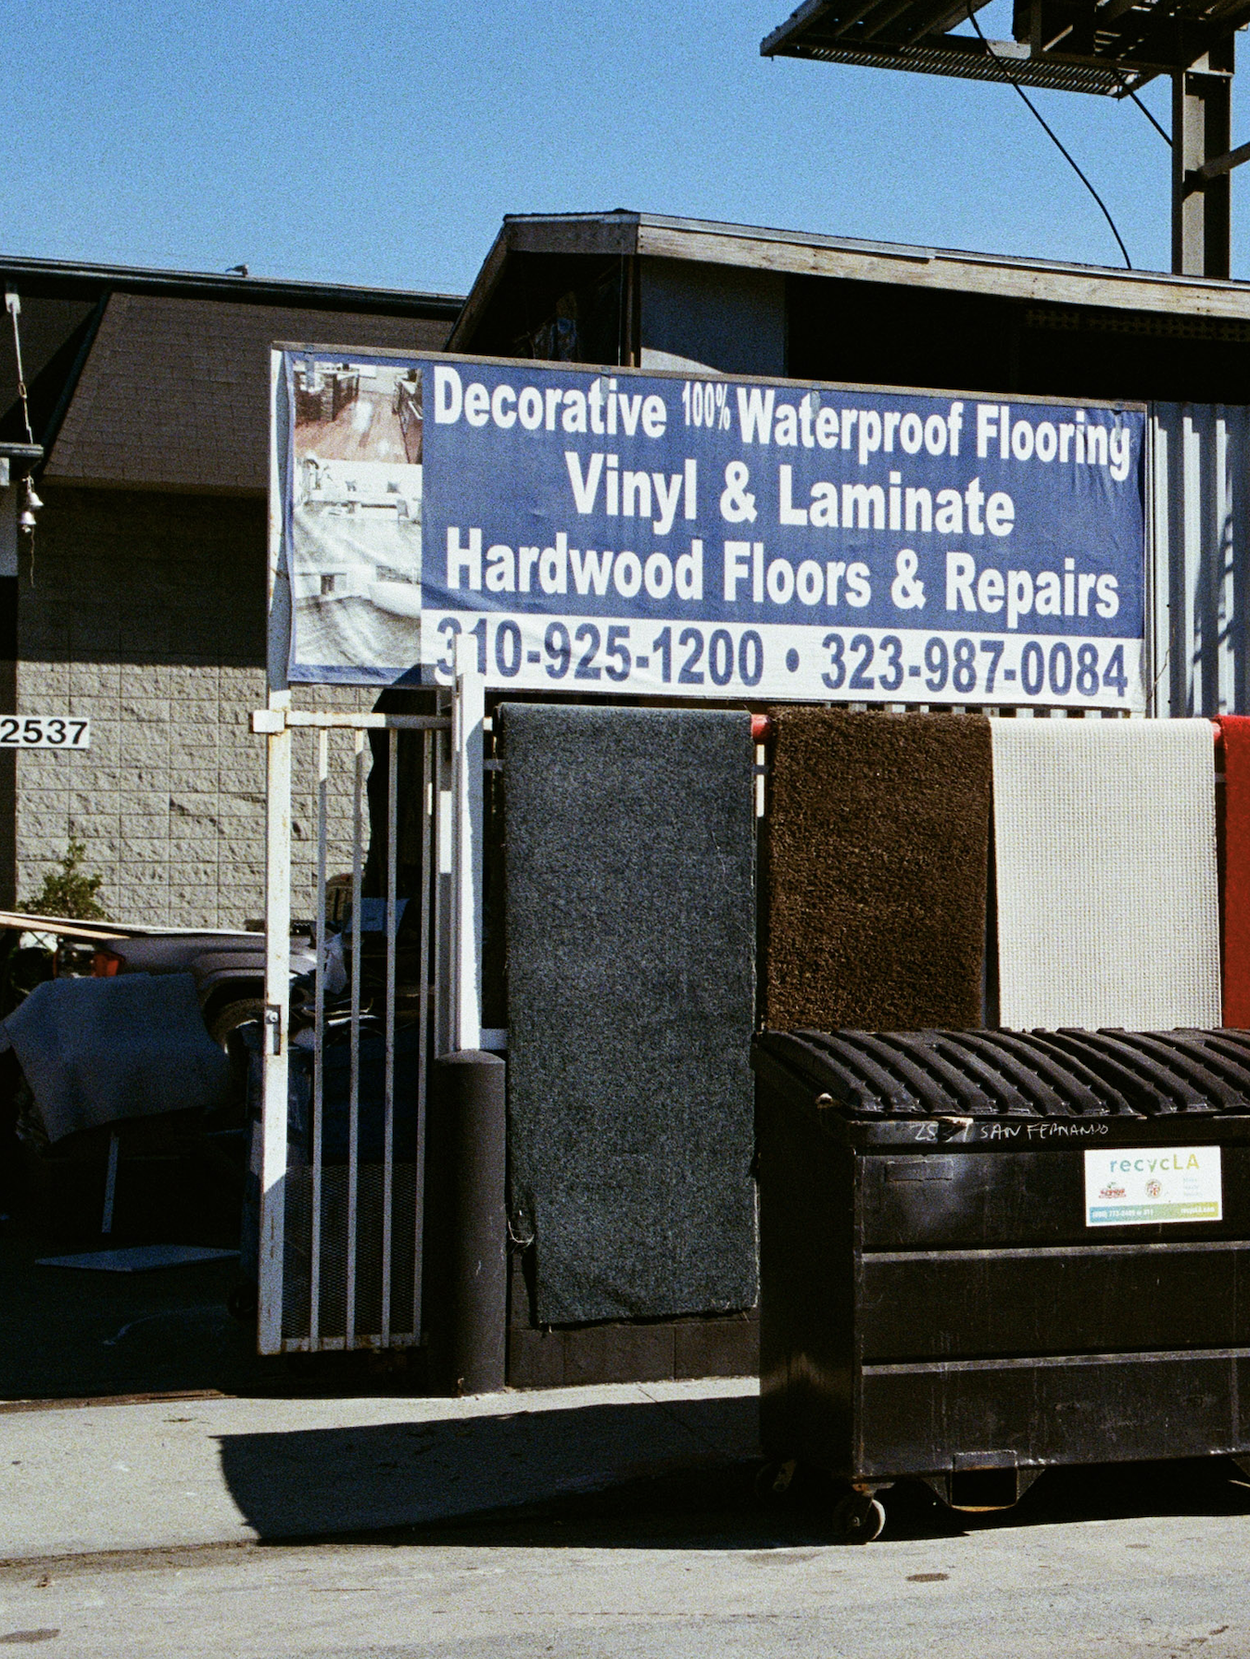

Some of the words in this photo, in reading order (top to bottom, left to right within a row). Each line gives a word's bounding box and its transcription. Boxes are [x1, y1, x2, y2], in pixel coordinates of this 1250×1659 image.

[433, 365, 668, 439] Decorative
[682, 380, 731, 431] 100%
[736, 386, 964, 466] Waterproof
[976, 403, 1132, 482] Flooring
[564, 451, 697, 536] Vinyl
[719, 461, 758, 524] &
[779, 464, 1015, 537] Laminate
[446, 526, 703, 600] Hardwood
[723, 540, 871, 608] Floors
[890, 549, 927, 610] &
[945, 550, 1120, 629] Repairs
[436, 616, 765, 687] 310-925-1200
[821, 632, 1128, 698] 323-987-0084
[0, 718, 88, 744] 2537
[979, 1123, 1022, 1140] SAN
[1109, 1153, 1200, 1173] recycLA
